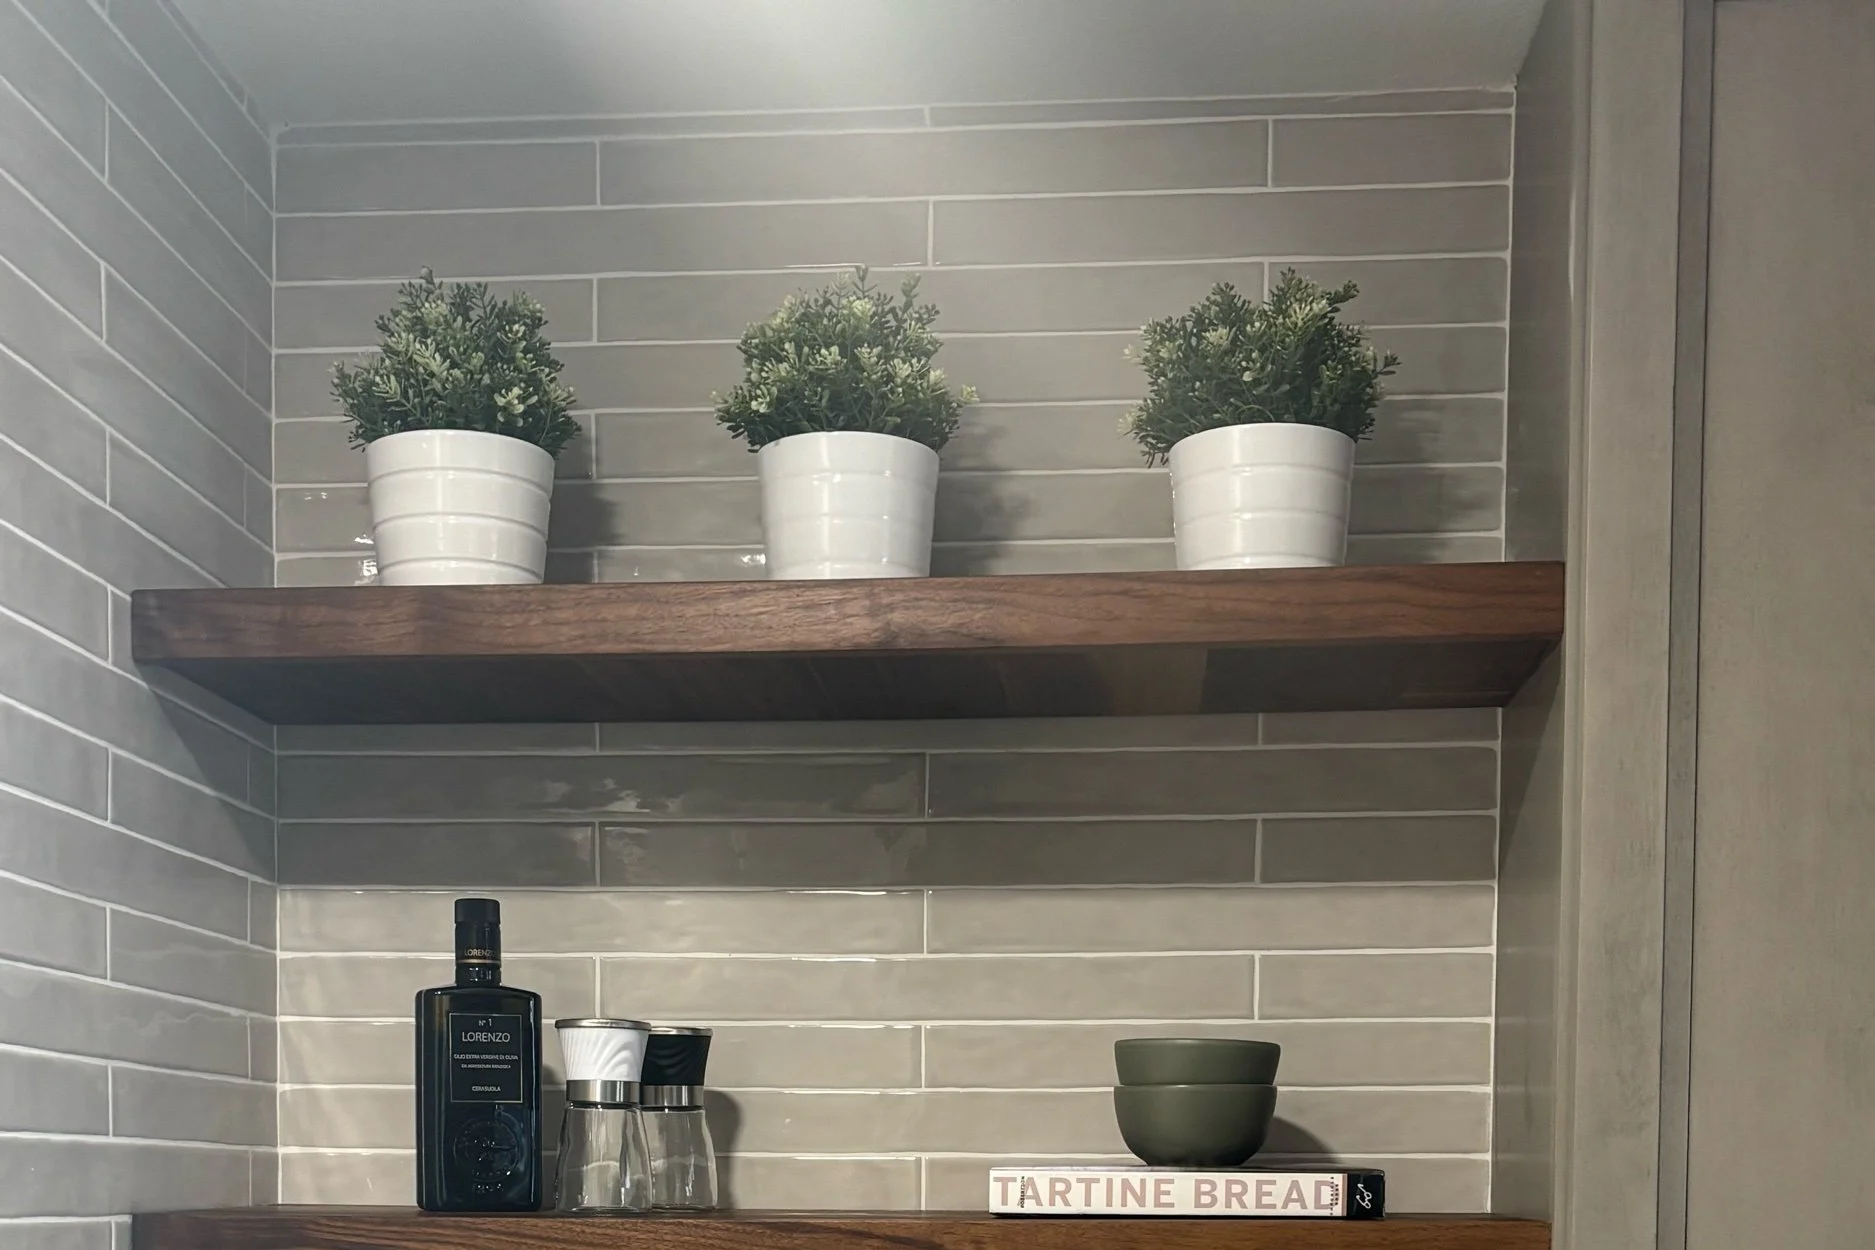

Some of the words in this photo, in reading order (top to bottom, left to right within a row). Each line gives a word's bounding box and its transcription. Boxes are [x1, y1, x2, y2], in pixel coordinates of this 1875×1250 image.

[461, 1031, 511, 1043] LORENZO
[993, 1176, 1175, 1208] TARTINE
[1193, 1178, 1337, 1210] BREAD
